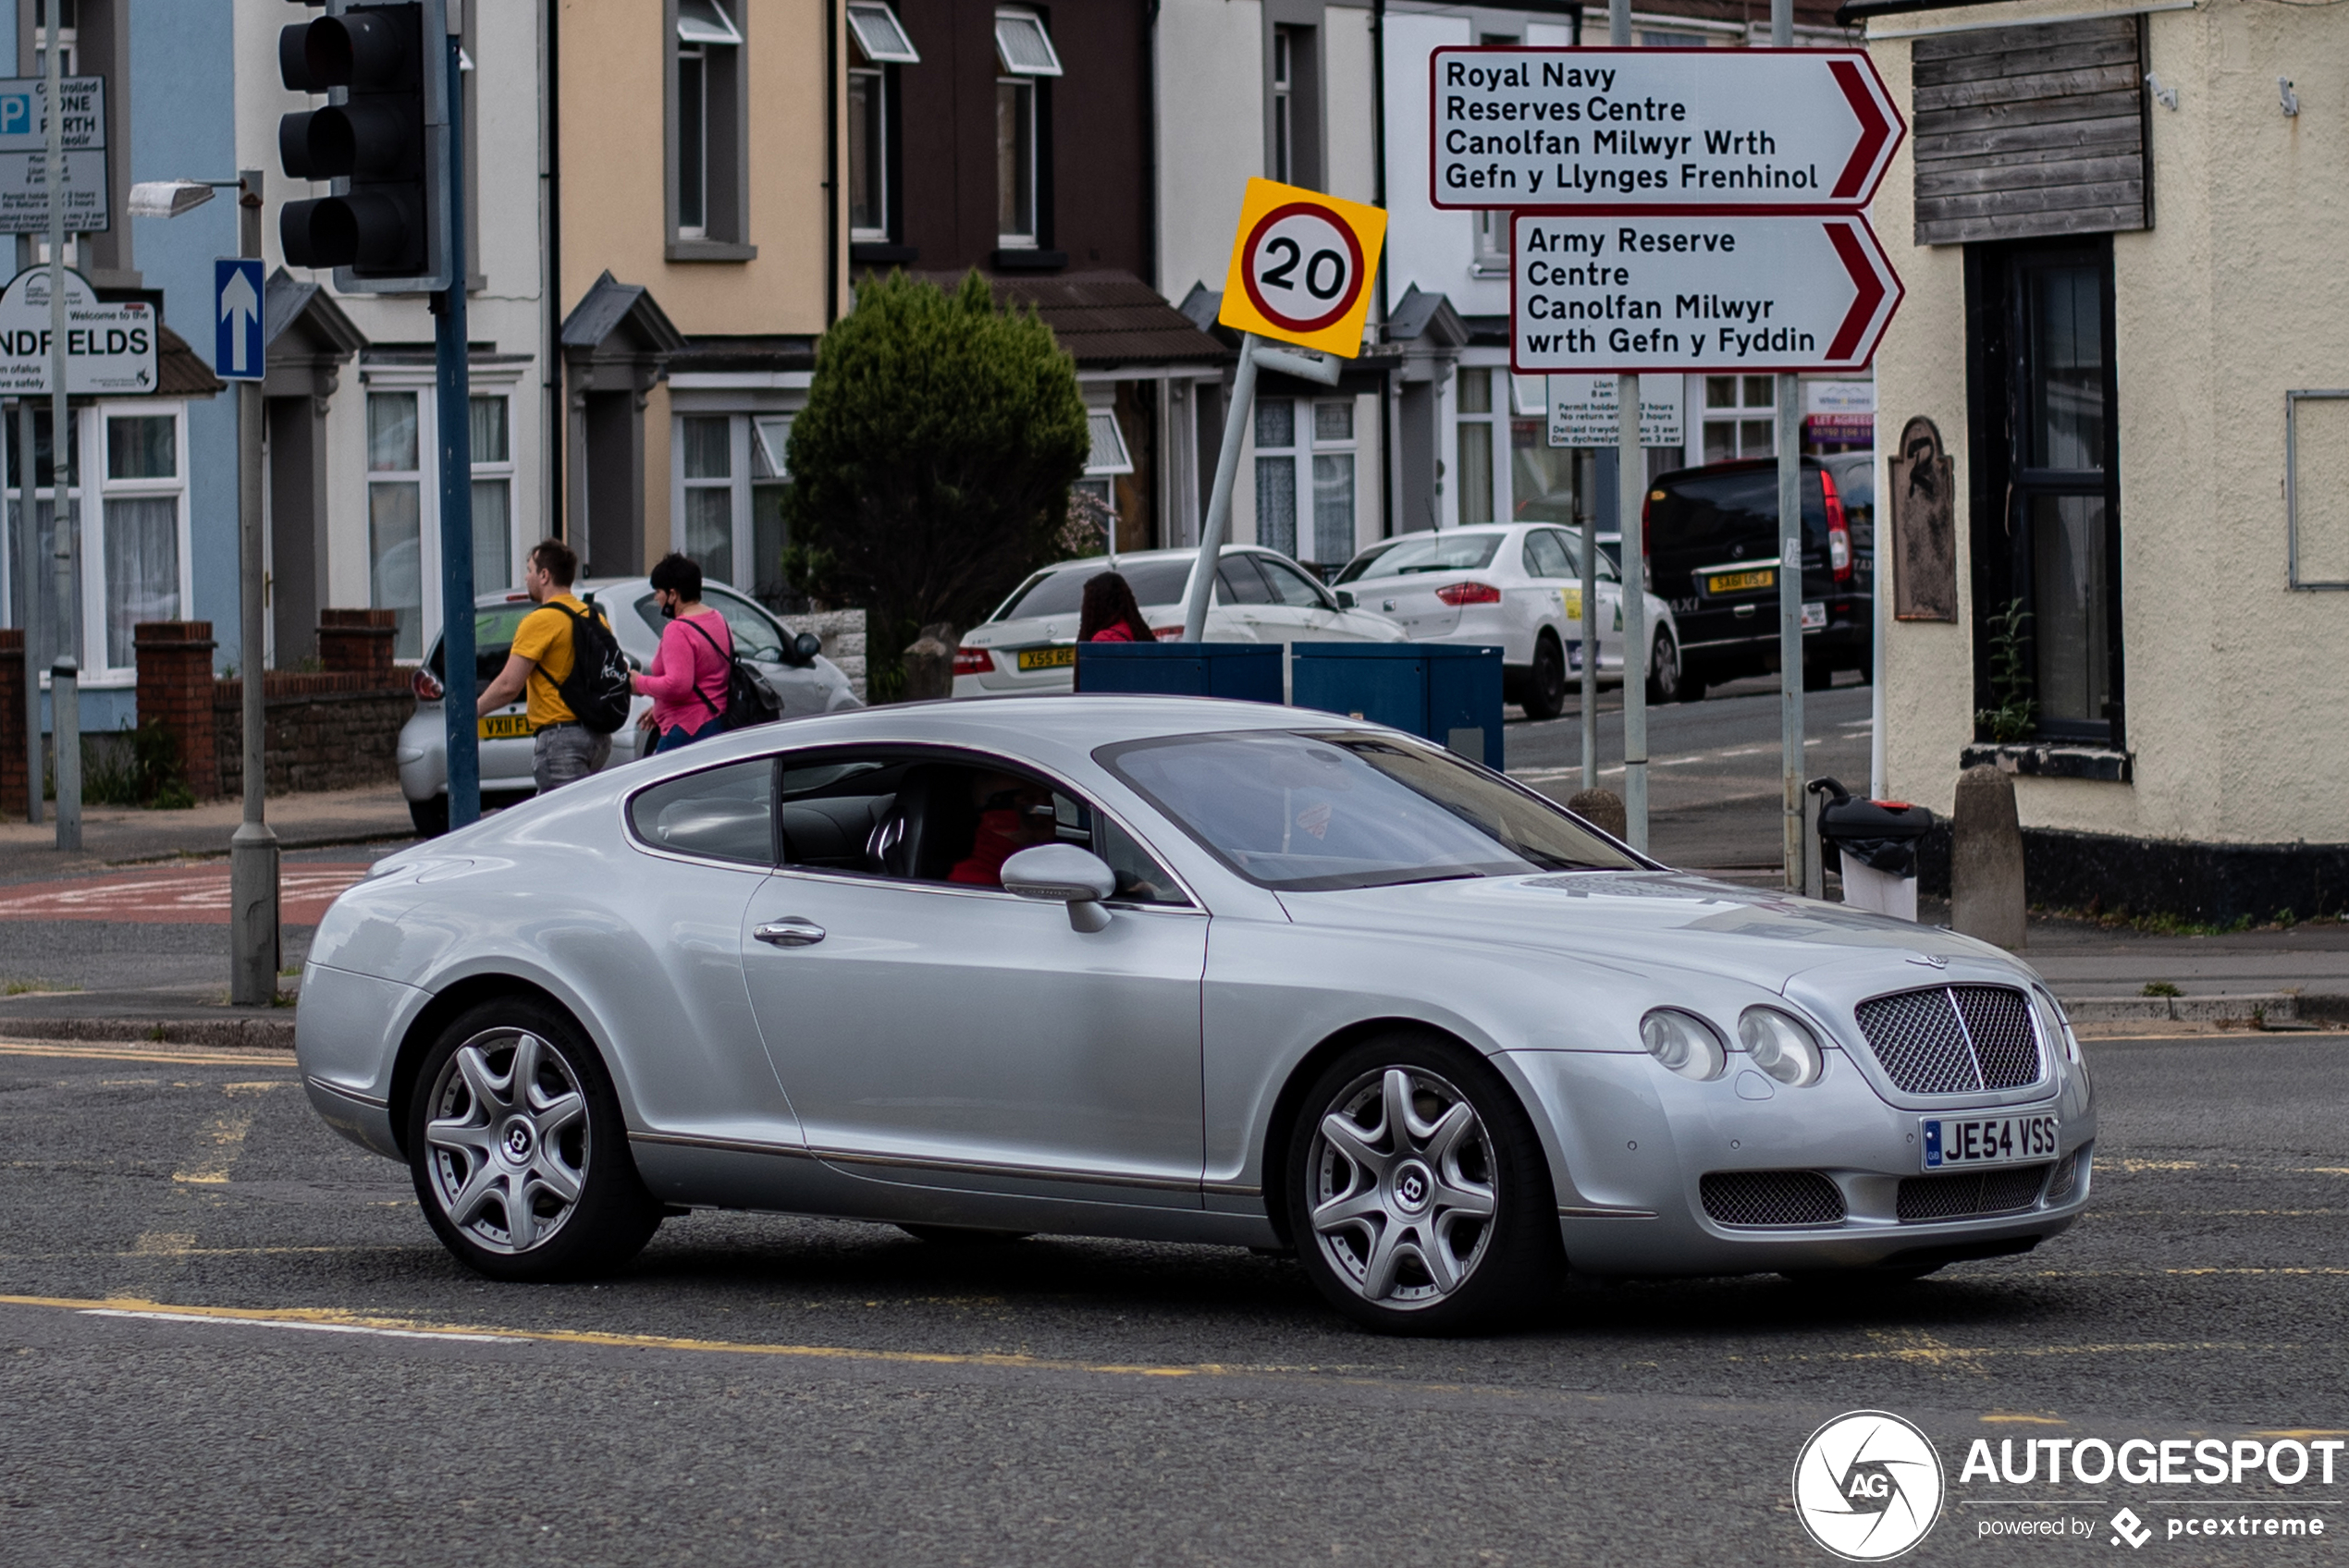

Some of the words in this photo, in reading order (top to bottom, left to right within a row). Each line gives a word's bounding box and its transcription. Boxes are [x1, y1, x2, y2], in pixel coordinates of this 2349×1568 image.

[35, 81, 97, 94] Ctrolled
[1446, 62, 1530, 92] Royal
[1543, 62, 1617, 92] Navy
[1446, 96, 1581, 121] Reserves
[1587, 96, 1686, 121] Centre
[40, 116, 95, 134] PRTH
[1445, 129, 1580, 155] Canolfan
[1594, 129, 1691, 159] Milwyr
[1704, 129, 1776, 155] Wrth
[1445, 163, 1517, 189] Gefn
[1529, 169, 1543, 193] y
[1557, 163, 1668, 193] Llynges
[1681, 164, 1818, 189] Frenhinol
[1527, 227, 1605, 257] Army
[1618, 227, 1736, 252] Reserve
[1261, 237, 1346, 300] 20
[1527, 261, 1629, 286] Centre
[69, 311, 117, 321] Welcome
[119, 312, 130, 320] to
[132, 311, 149, 320] the
[1527, 294, 1661, 320] Canolfan
[1676, 294, 1774, 324] Milwyr
[0, 328, 149, 356] NDFELDS
[1526, 328, 1596, 353] wrth
[1609, 328, 1679, 353] Gefn
[1691, 334, 1706, 357] y
[1719, 327, 1814, 357] Fyddin
[15, 378, 44, 389] safely
[1814, 415, 1830, 425] LET
[1670, 596, 1699, 613] AXI
[1028, 652, 1053, 666] X55
[1057, 650, 1073, 663] RE
[486, 718, 512, 734] VX11
[1945, 1120, 2013, 1160] JE54
[2019, 1117, 2056, 1156] VSS
[1927, 1151, 1939, 1160] GB
